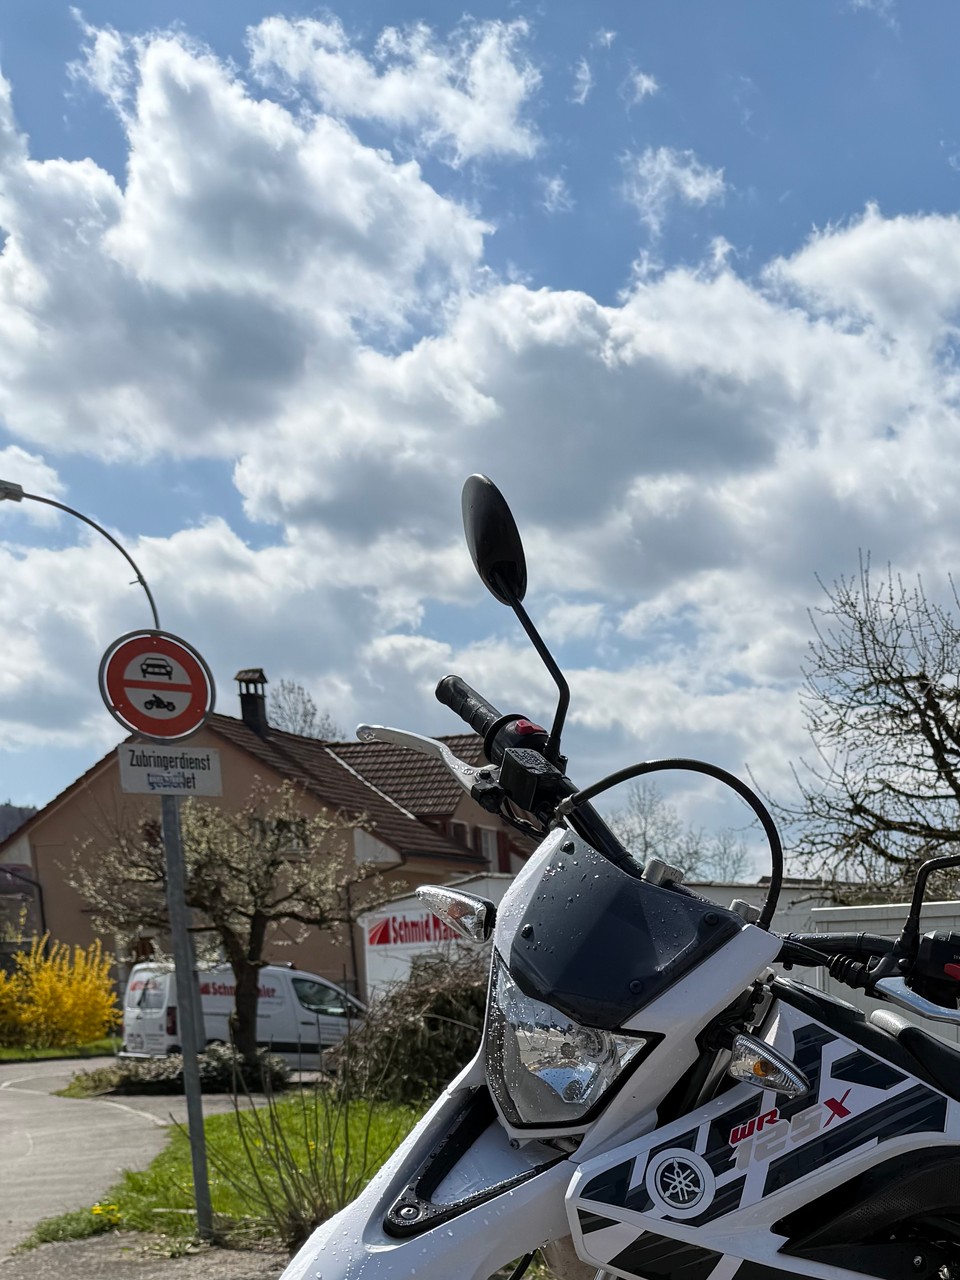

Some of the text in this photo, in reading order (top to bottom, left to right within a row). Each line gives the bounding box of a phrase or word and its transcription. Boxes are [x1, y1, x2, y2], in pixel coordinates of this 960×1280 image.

[128, 749, 211, 771] Zubringerdienst
[391, 913, 431, 944] Schmid
[731, 1108, 780, 1145] WR
